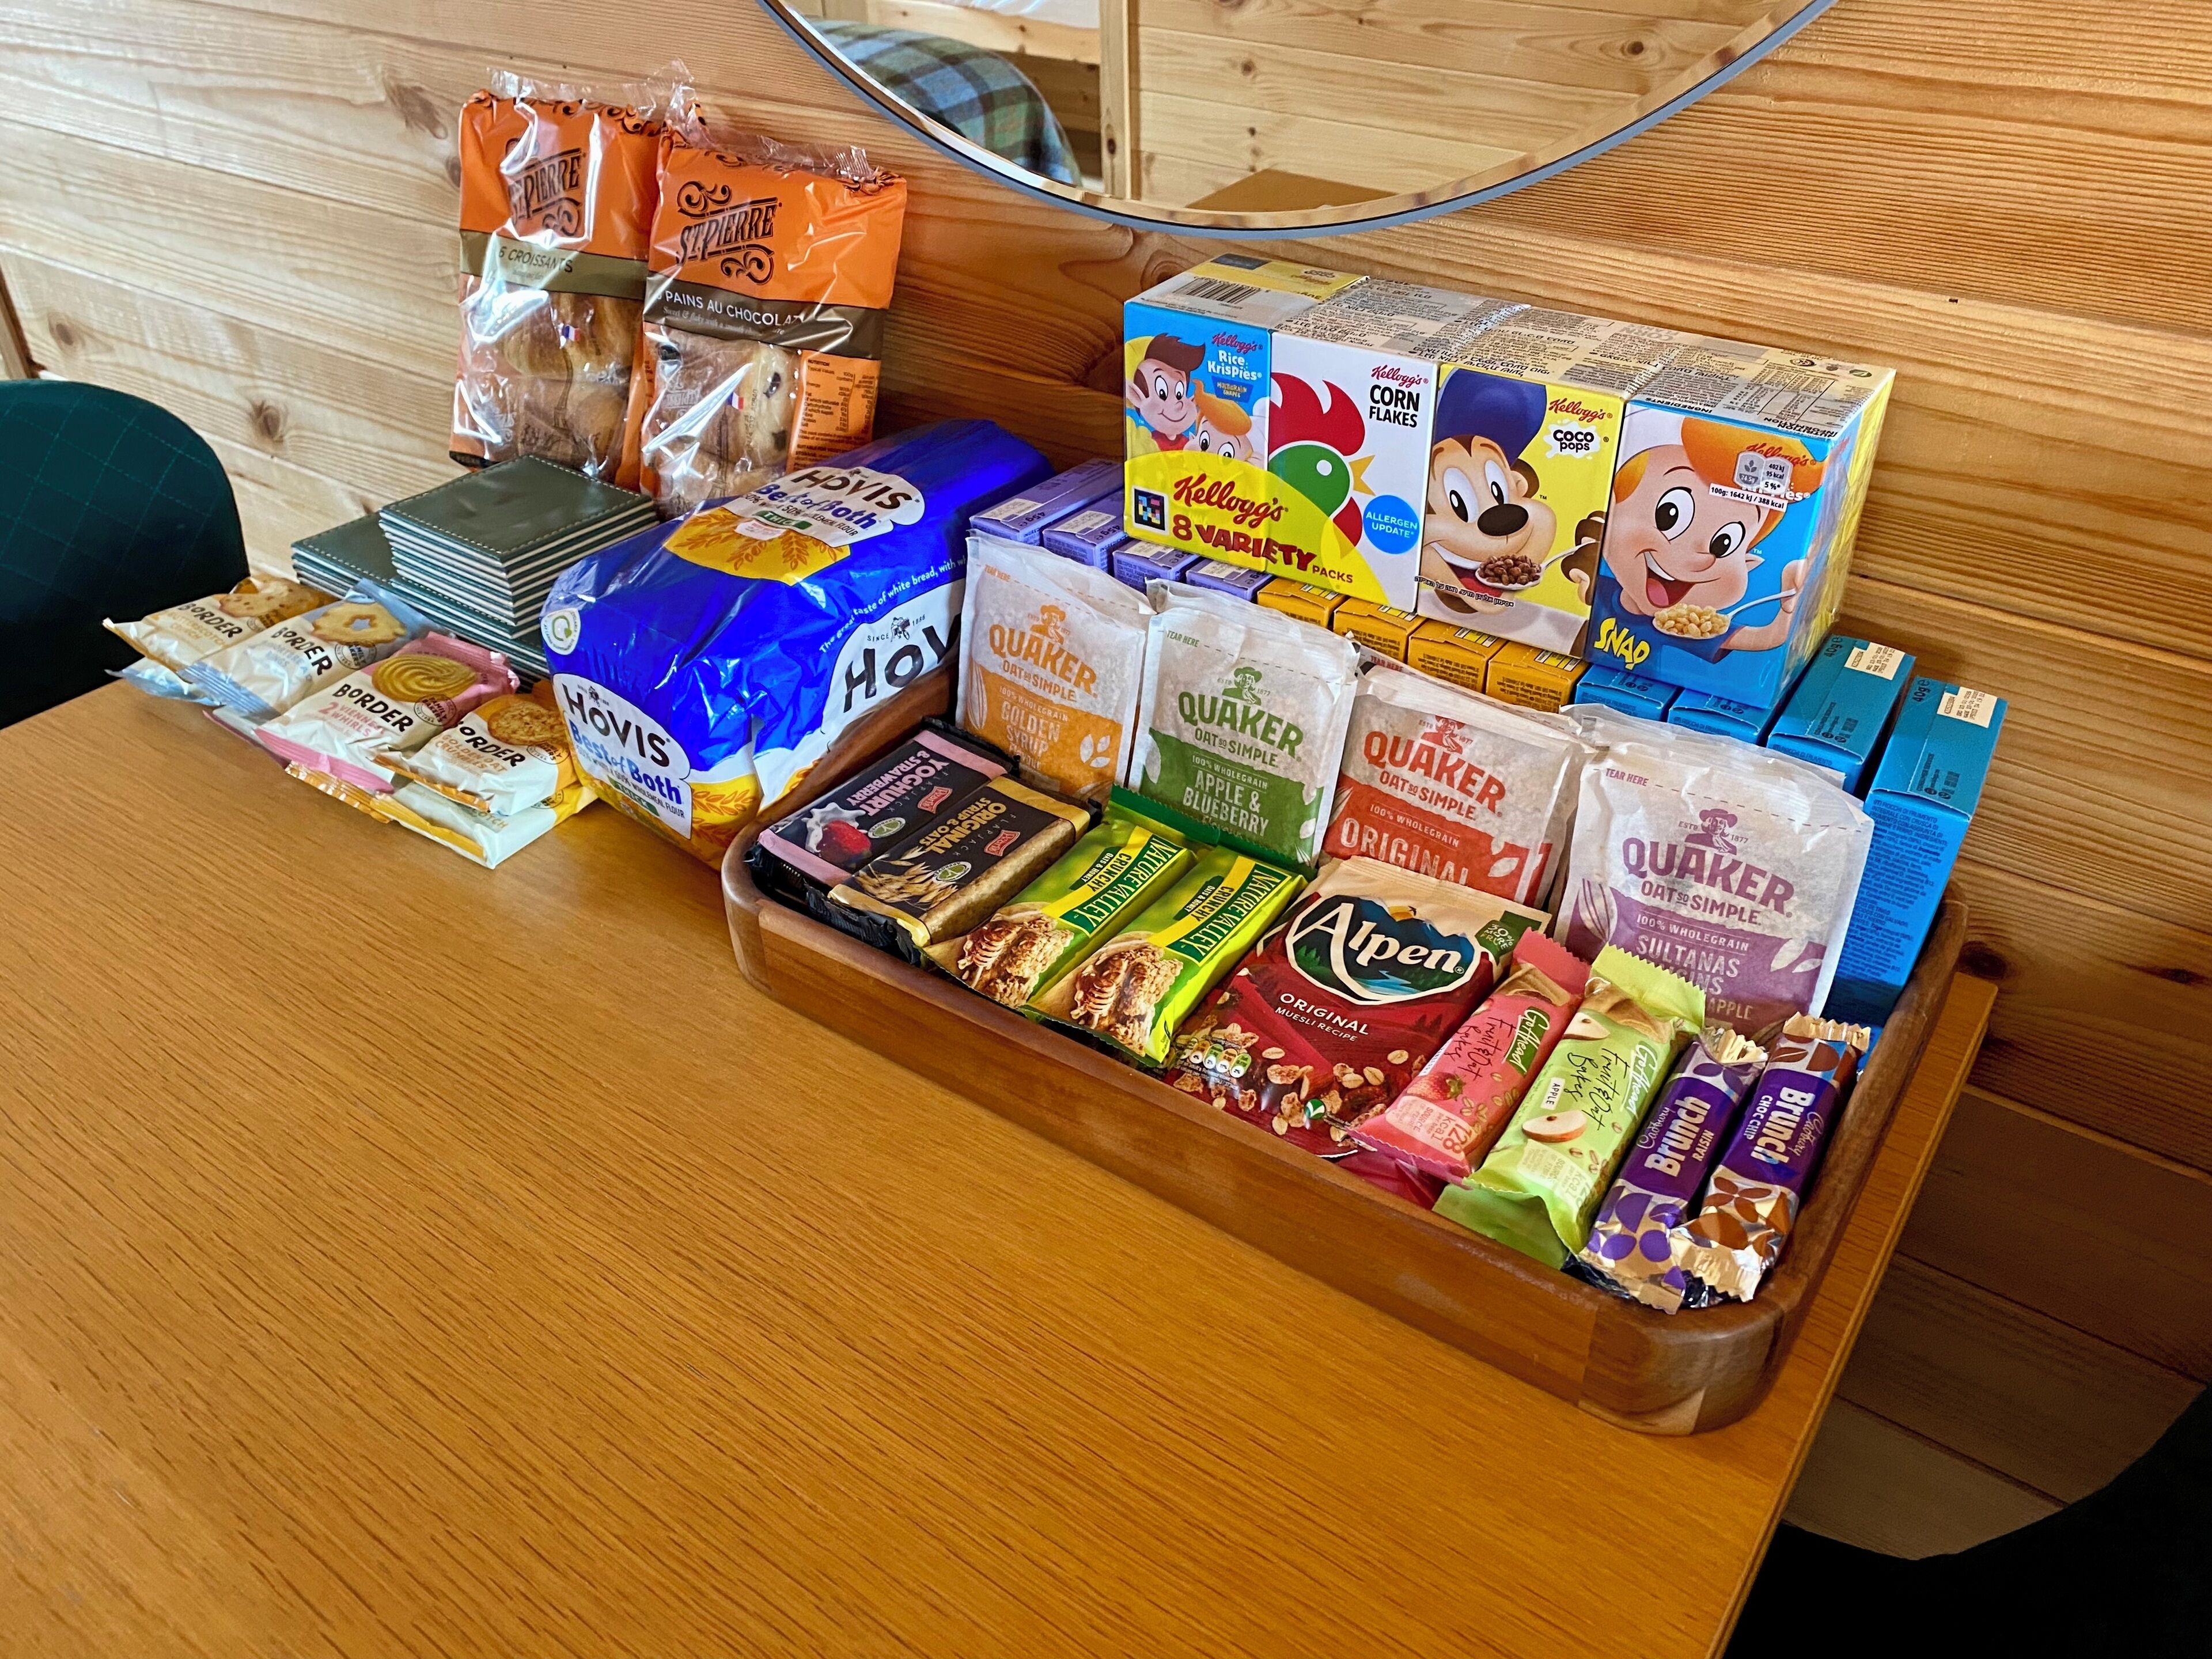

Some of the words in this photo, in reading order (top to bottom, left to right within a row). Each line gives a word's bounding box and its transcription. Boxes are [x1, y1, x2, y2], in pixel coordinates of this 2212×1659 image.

[665, 290, 703, 309] PAINS
[707, 300, 722, 314] AU
[1211, 331, 1258, 355] Kellogg's
[1218, 350, 1245, 366] Rice
[1207, 360, 1257, 381] Krispies
[1371, 365, 1423, 389] Kellogg's
[1369, 383, 1420, 412] CORN
[1549, 398, 1607, 423] Kellogg's
[1645, 397, 1713, 414] INGREDIENTS
[1368, 406, 1418, 429] FLAKES
[790, 469, 914, 510] HOVIS
[1773, 472, 1785, 480] kcal
[800, 495, 830, 510] of
[818, 500, 878, 531] Both
[1172, 474, 1285, 529] Kellogg's
[1711, 487, 1729, 497] 100g:
[1730, 490, 1745, 499] 1642
[1758, 497, 1770, 506] 388
[1771, 499, 1785, 509] kcal
[781, 505, 802, 517] 50%
[836, 521, 858, 537] FLOUR
[1103, 524, 1121, 537] 45g
[1365, 511, 1418, 531] ALLERGEN
[1172, 514, 1194, 541] 8
[1195, 523, 1317, 573] VARIETY
[1312, 564, 1354, 584] PACKS
[177, 603, 243, 639] BORDER
[819, 635, 836, 653] The
[836, 615, 855, 639] great
[853, 601, 877, 616] taste
[878, 590, 888, 605] of
[887, 581, 911, 598] white
[911, 566, 939, 586] bread,
[938, 558, 956, 574] with
[270, 626, 334, 677] BORDER
[867, 633, 890, 642] SINCE
[1166, 629, 1182, 643] TEAR
[1182, 635, 1200, 649] HERE
[1593, 617, 1650, 670] SNAP
[1824, 643, 1843, 657] 40g
[988, 623, 1097, 691] QUAKER
[1002, 660, 1025, 681] OAT
[1031, 673, 1077, 702] SIMPLE
[1912, 686, 1931, 703] 40g
[317, 702, 339, 715] 2
[332, 683, 414, 733] BORDER
[999, 685, 1017, 702] 100%
[1017, 696, 1069, 722] WHOLEGRAIN
[332, 711, 370, 738] WHIRLS
[562, 684, 671, 768] HOVIS
[1001, 702, 1060, 743] GOLDEN
[1006, 725, 1049, 756] SYRUP
[1178, 691, 1304, 757] QUAKER
[442, 734, 483, 759] GOLDEN
[483, 757, 507, 772] OAT
[459, 724, 525, 767] ORDER
[569, 718, 612, 766] Best
[611, 755, 627, 774] of
[626, 757, 683, 805] Both
[916, 750, 931, 759] &
[1194, 728, 1218, 748] OAT
[1228, 740, 1277, 768] SIMPLE
[846, 755, 922, 806] STRAWBERRY
[859, 758, 950, 817] YOGHURT
[1192, 755, 1213, 770] 100%
[1213, 763, 1268, 789] WHOLEGRAIN
[1363, 730, 1506, 813] QUAKER
[1605, 767, 1626, 781] TEAR
[1626, 771, 1649, 787] HERE
[630, 781, 666, 809] WHOLEMEAL
[665, 802, 685, 819] FLOUR
[957, 797, 991, 821] SYRUP
[1194, 770, 1243, 807] APPLE
[1250, 792, 1261, 813] &
[1379, 770, 1410, 794] OAT
[1418, 786, 1477, 821] SIMPLE
[925, 802, 1007, 855] ORIGINAL
[946, 818, 960, 826] &
[1182, 786, 1270, 838] BLUEBERRY
[1370, 804, 1395, 821] 100%
[1396, 815, 1460, 848] WHOLEGRAIN
[919, 825, 950, 847] OATS
[952, 813, 1017, 857] FLAPJACK
[1081, 868, 1099, 882] HONEY
[1086, 853, 1132, 892] CRUNCHY
[1100, 852, 1115, 864] OATS
[1123, 837, 1179, 888] NATURE
[1622, 837, 1794, 915] QUAKER
[1073, 883, 1137, 928] VALLEY
[1184, 898, 1203, 912] HONEY
[1190, 885, 1235, 922] CRUNCHY
[1205, 885, 1216, 896] OATS
[1227, 869, 1282, 916] NATURE
[1641, 880, 1677, 902] OAT
[1690, 892, 1759, 925] SIMPLE
[1179, 912, 1241, 956] VALLEY
[1296, 902, 1456, 982] Alpen
[1483, 929, 1509, 950] MORE
[1637, 914, 1666, 931] 100%
[1669, 923, 1749, 952] WHOLEGRAIN
[1636, 934, 1740, 978] SULTANAS
[1274, 1006, 1317, 1031] MUESLI
[1319, 1021, 1358, 1043] RECIPE
[1279, 991, 1370, 1036] ORIGINAL
[1707, 997, 1754, 1021] APPLE
[1444, 1025, 1482, 1062] Bakes
[1477, 1017, 1516, 1055] Fruit
[1563, 1052, 1599, 1102] Bakes
[1595, 1047, 1630, 1099] Fruit
[1545, 1082, 1560, 1106] APPLE
[1581, 1092, 1613, 1131] Oat
[1753, 1094, 1774, 1120] CHOC
[1413, 1107, 1433, 1132] SOURCE
[1431, 1115, 1456, 1141] kcal
[1637, 1106, 1670, 1150] Cadbury
[1643, 1096, 1712, 1178] Brunch
[1745, 1119, 1765, 1141] CHIP
[1750, 1086, 1816, 1164] Brunch
[1790, 1111, 1825, 1157] Cadbury
[1442, 1123, 1472, 1154] 128
[1691, 1130, 1715, 1162] RAISIN
